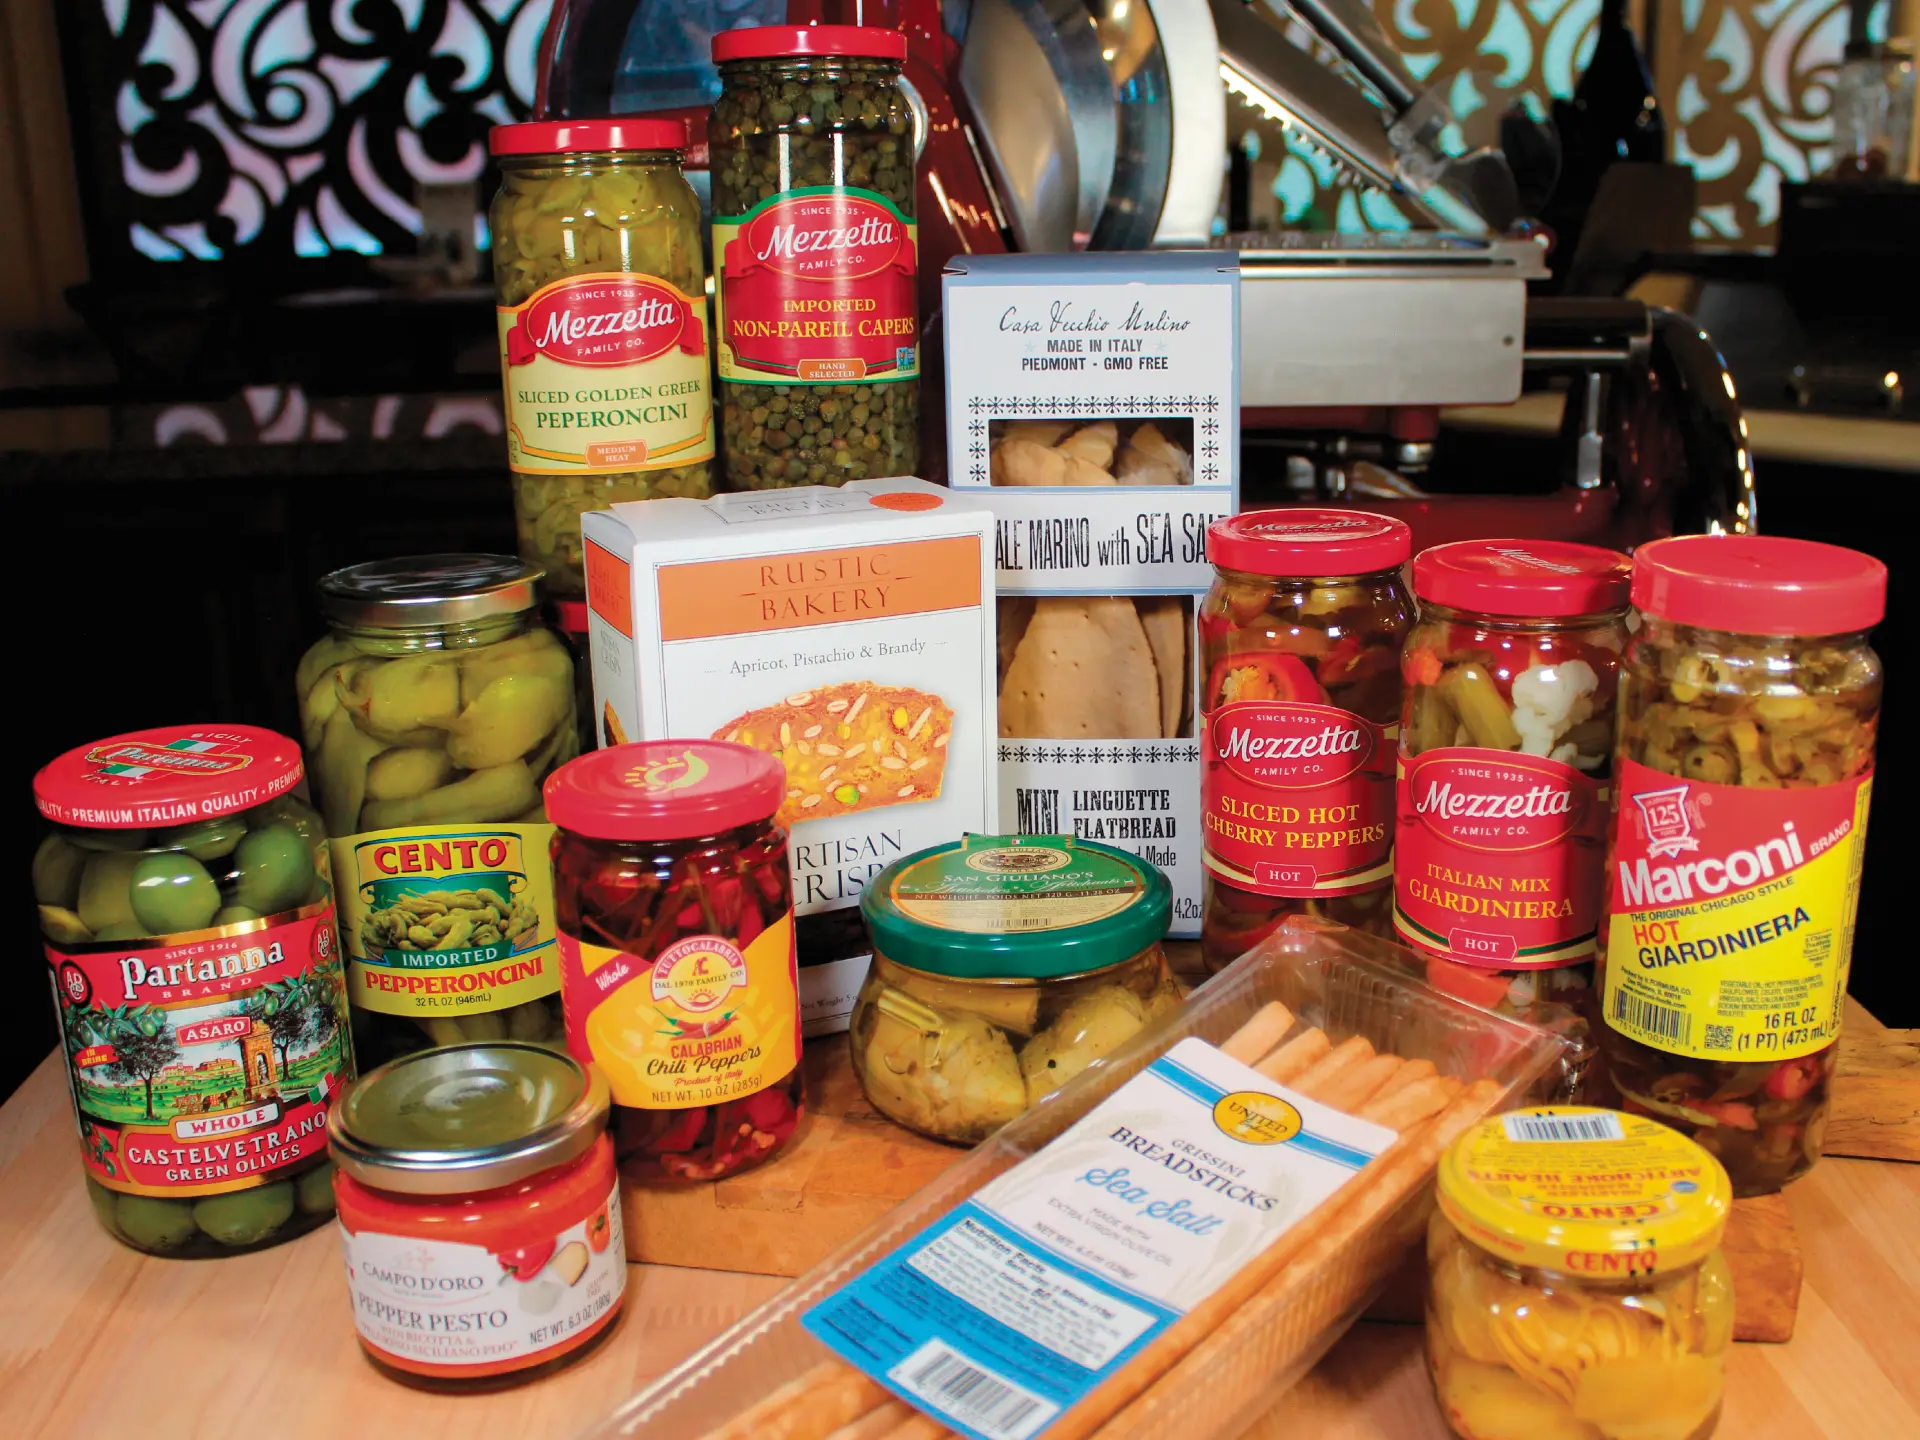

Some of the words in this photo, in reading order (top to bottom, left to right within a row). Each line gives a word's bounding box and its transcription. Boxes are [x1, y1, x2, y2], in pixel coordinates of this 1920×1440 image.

[801, 207, 831, 215] SINCE
[757, 217, 894, 260] Mezzetta
[799, 259, 842, 271] FAMILY
[847, 255, 865, 265] CO.
[575, 290, 606, 300] SINCE
[611, 290, 634, 298] 1935
[784, 299, 876, 313] IMPORTED
[536, 298, 675, 347] Mezzetta
[733, 320, 852, 339] NON-PAREIL
[858, 317, 914, 337] CAPERS
[999, 305, 1043, 334] Casa
[1049, 300, 1110, 333] Vecchio
[1118, 300, 1191, 332] Mulino
[577, 342, 621, 356] FAMILY
[626, 338, 644, 348] CO.
[1047, 339, 1083, 353] MADE
[1090, 340, 1102, 353] IN
[1108, 339, 1143, 353] ITALY
[809, 370, 855, 379] SELECTED
[1022, 357, 1087, 371] PIEDMONT
[1104, 357, 1133, 371] GMO
[1139, 357, 1169, 370] FREE
[518, 390, 569, 404] SLICED
[575, 386, 652, 402] GOLDEN
[658, 380, 701, 396] GREEK
[536, 403, 688, 429] PEPERONCINI
[597, 445, 636, 455] MEDIUM
[605, 454, 629, 462] HEAT
[1241, 520, 1369, 532] Mezzetta
[995, 519, 1023, 570] ALE
[1029, 517, 1091, 570] MARINO
[1097, 526, 1130, 566] with
[1136, 512, 1174, 564] SEA
[1182, 512, 1229, 564] SA
[760, 552, 891, 588] RUSTIC
[762, 585, 892, 622] BAKERY
[729, 659, 788, 676] Apricot,
[794, 649, 855, 668] Pistachio
[860, 645, 873, 659] &
[878, 639, 926, 658] Brandy
[1256, 714, 1286, 722] SINCE
[1291, 716, 1316, 724] 1935
[1219, 725, 1360, 763] Mezzetta
[106, 747, 231, 769] Partanna
[1254, 767, 1298, 776] FAMILY
[1303, 764, 1323, 774] CO.
[1458, 768, 1491, 778] SINCE
[1496, 772, 1524, 782] 1935
[72, 807, 133, 823] PREMIUM
[137, 803, 197, 822] ITALIAN
[202, 787, 258, 813] QUALITY
[1016, 789, 1059, 835] MINI
[1073, 790, 1170, 811] LINGUETTE
[1221, 796, 1300, 824] SLICED
[1308, 804, 1360, 825] HOT
[1416, 781, 1572, 819] Mezzetta
[1073, 817, 1176, 839] FLATBREAD
[1648, 803, 1680, 827] 125
[1206, 811, 1278, 846] CHERRY
[1284, 823, 1385, 849] PEPPERS
[1453, 826, 1501, 836] FAMILY
[1507, 826, 1529, 835] CO.
[374, 839, 507, 874] CENTO
[796, 829, 902, 870] RTISAN
[1146, 846, 1176, 867] Made
[1269, 870, 1300, 881] HOT
[1619, 821, 1804, 907] Marconi
[1810, 819, 1852, 857] BRAND
[943, 874, 979, 882] SAN
[985, 871, 1094, 883] GIULIANO'S
[1427, 863, 1503, 892] ITALIAN
[1509, 878, 1551, 892] MIX
[938, 893, 979, 901] WEIGHT
[1409, 878, 1574, 919] GIARDINIERA
[1630, 912, 1646, 923] THE
[1649, 906, 1698, 921] ORIGINAL
[1700, 891, 1756, 913] CHICAGO
[1759, 877, 1796, 898] STYLE
[1465, 938, 1499, 953] HOT
[1633, 920, 1681, 946] HOT
[1639, 906, 1811, 969] GIARDINIERA
[164, 946, 205, 960] SINCE
[210, 941, 238, 952] 1916
[402, 947, 498, 968] IMPORTED
[657, 940, 739, 978] TUTTOCALABRIA
[120, 941, 284, 1000] Partanna
[364, 956, 543, 994] PEPPERONCINI
[595, 963, 630, 991] Whole
[655, 981, 672, 989] DAL
[695, 973, 728, 986] FAMILY
[730, 969, 744, 979] CO.
[162, 977, 253, 999] BRAND
[415, 997, 427, 1007] 32
[429, 997, 440, 1007] FL
[441, 996, 453, 1006] OZ
[455, 993, 492, 1007] (946mL)
[186, 1020, 246, 1041] ASARO
[1765, 1012, 1780, 1029] 16
[1784, 1011, 1798, 1027] FL
[1801, 1007, 1817, 1024] OZ
[670, 1034, 742, 1060] CALABRIAN
[1738, 1033, 1750, 1052] (1
[1756, 1032, 1778, 1052] PT)
[1783, 1028, 1809, 1051] (473
[1811, 1020, 1828, 1041] mL)
[81, 1054, 108, 1066] BRINE
[86, 1048, 96, 1057] IN
[647, 1058, 687, 1076] Chili
[693, 1045, 761, 1073] Peppers
[652, 1091, 673, 1103] NET
[675, 1089, 695, 1101] WT.
[700, 1086, 713, 1099] 10
[715, 1083, 729, 1096] OZ
[732, 1074, 762, 1094] (285g)
[674, 1074, 711, 1087] Product
[714, 1072, 723, 1084] of
[191, 1108, 266, 1134] WHOLE
[1229, 1101, 1288, 1134] UNITED
[128, 1111, 327, 1165] CASTELVETRANO
[166, 1163, 229, 1182] GREEN
[235, 1143, 301, 1173] OLIVES
[1109, 1126, 1279, 1212] BREADSTICKS
[1171, 1138, 1246, 1178] GRISSINI
[1075, 1167, 1149, 1205] Sea
[1137, 1199, 1224, 1236] Salt
[1543, 1204, 1660, 1218] CENTO
[1033, 1221, 1055, 1238] NET
[1090, 1206, 1121, 1228] MADE
[1048, 1198, 1085, 1223] EXTRA
[1083, 1215, 1120, 1240] VIRGIN
[1120, 1235, 1152, 1260] OLIVE
[1154, 1251, 1173, 1267] OIL
[964, 1219, 1011, 1254] Nutrition
[1013, 1251, 1046, 1275] Facts
[1566, 1250, 1657, 1272] CENTO
[362, 1261, 417, 1289] CAMPO
[421, 1276, 483, 1291] D'ORO
[359, 1292, 424, 1331] PEPPER
[428, 1310, 508, 1333] PESTO
[530, 1328, 548, 1345] NET
[550, 1321, 567, 1337] WT.
[568, 1313, 581, 1330] 6.3
[582, 1305, 592, 1322] OZ
[406, 1329, 463, 1346] RICOTTA
